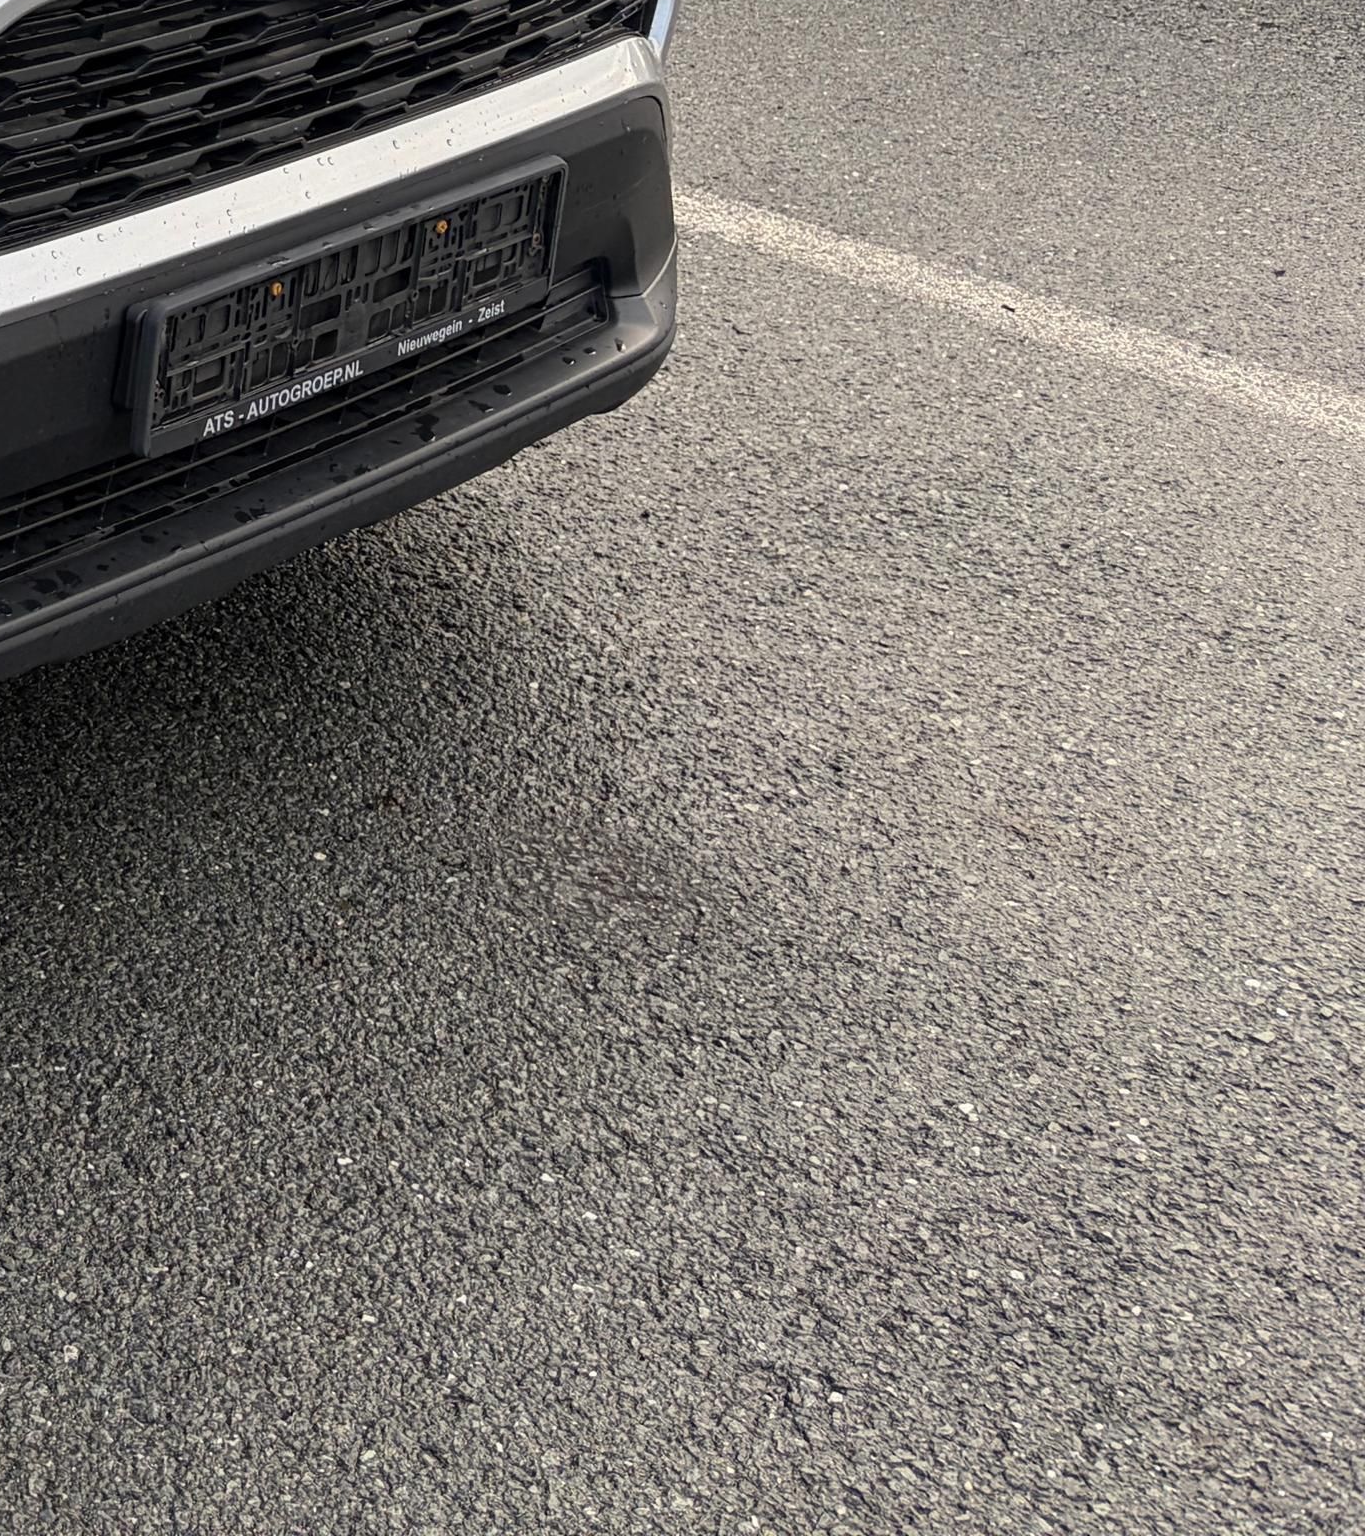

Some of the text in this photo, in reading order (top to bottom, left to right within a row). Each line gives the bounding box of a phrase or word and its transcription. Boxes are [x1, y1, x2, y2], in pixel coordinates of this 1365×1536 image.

[202, 409, 235, 438] ATS
[245, 358, 365, 421] AUTOGROEP.NL
[396, 318, 464, 358] Nieuwegein
[477, 298, 506, 324] Zeist
